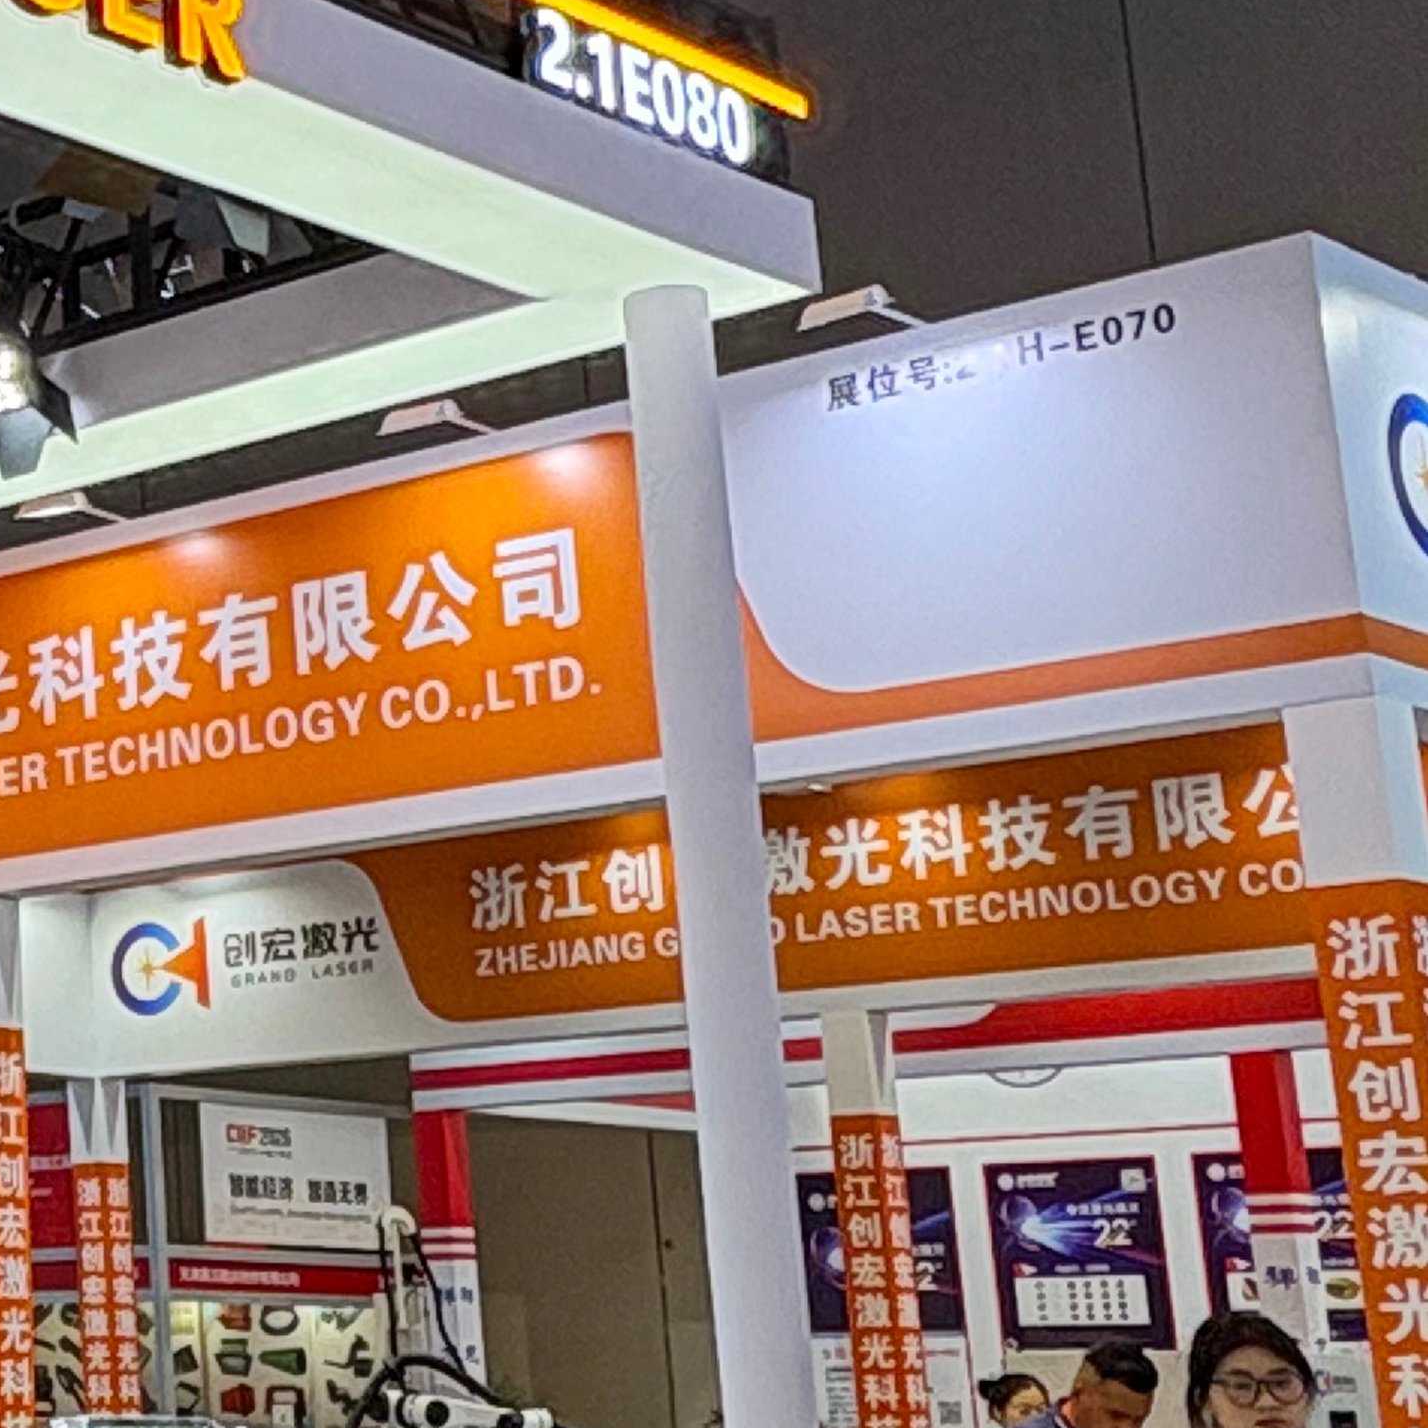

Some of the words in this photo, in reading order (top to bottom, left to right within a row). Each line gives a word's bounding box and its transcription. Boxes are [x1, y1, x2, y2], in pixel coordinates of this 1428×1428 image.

[535, 6, 753, 166] 2.1E080
[55, 692, 368, 788] TECHNOLOGY
[379, 655, 603, 732] CO.,LTD.
[224, 916, 380, 968] 创宏激光
[230, 967, 296, 989] GRAND
[311, 958, 375, 980] LASER
[474, 936, 647, 978] ZHEJIANG
[794, 900, 923, 945] LASER
[929, 867, 1227, 928] TECHNOLOGY
[77, 1178, 112, 1413] 浙江创宏激光科
[107, 1178, 141, 1413] 浙江创宏激光科
